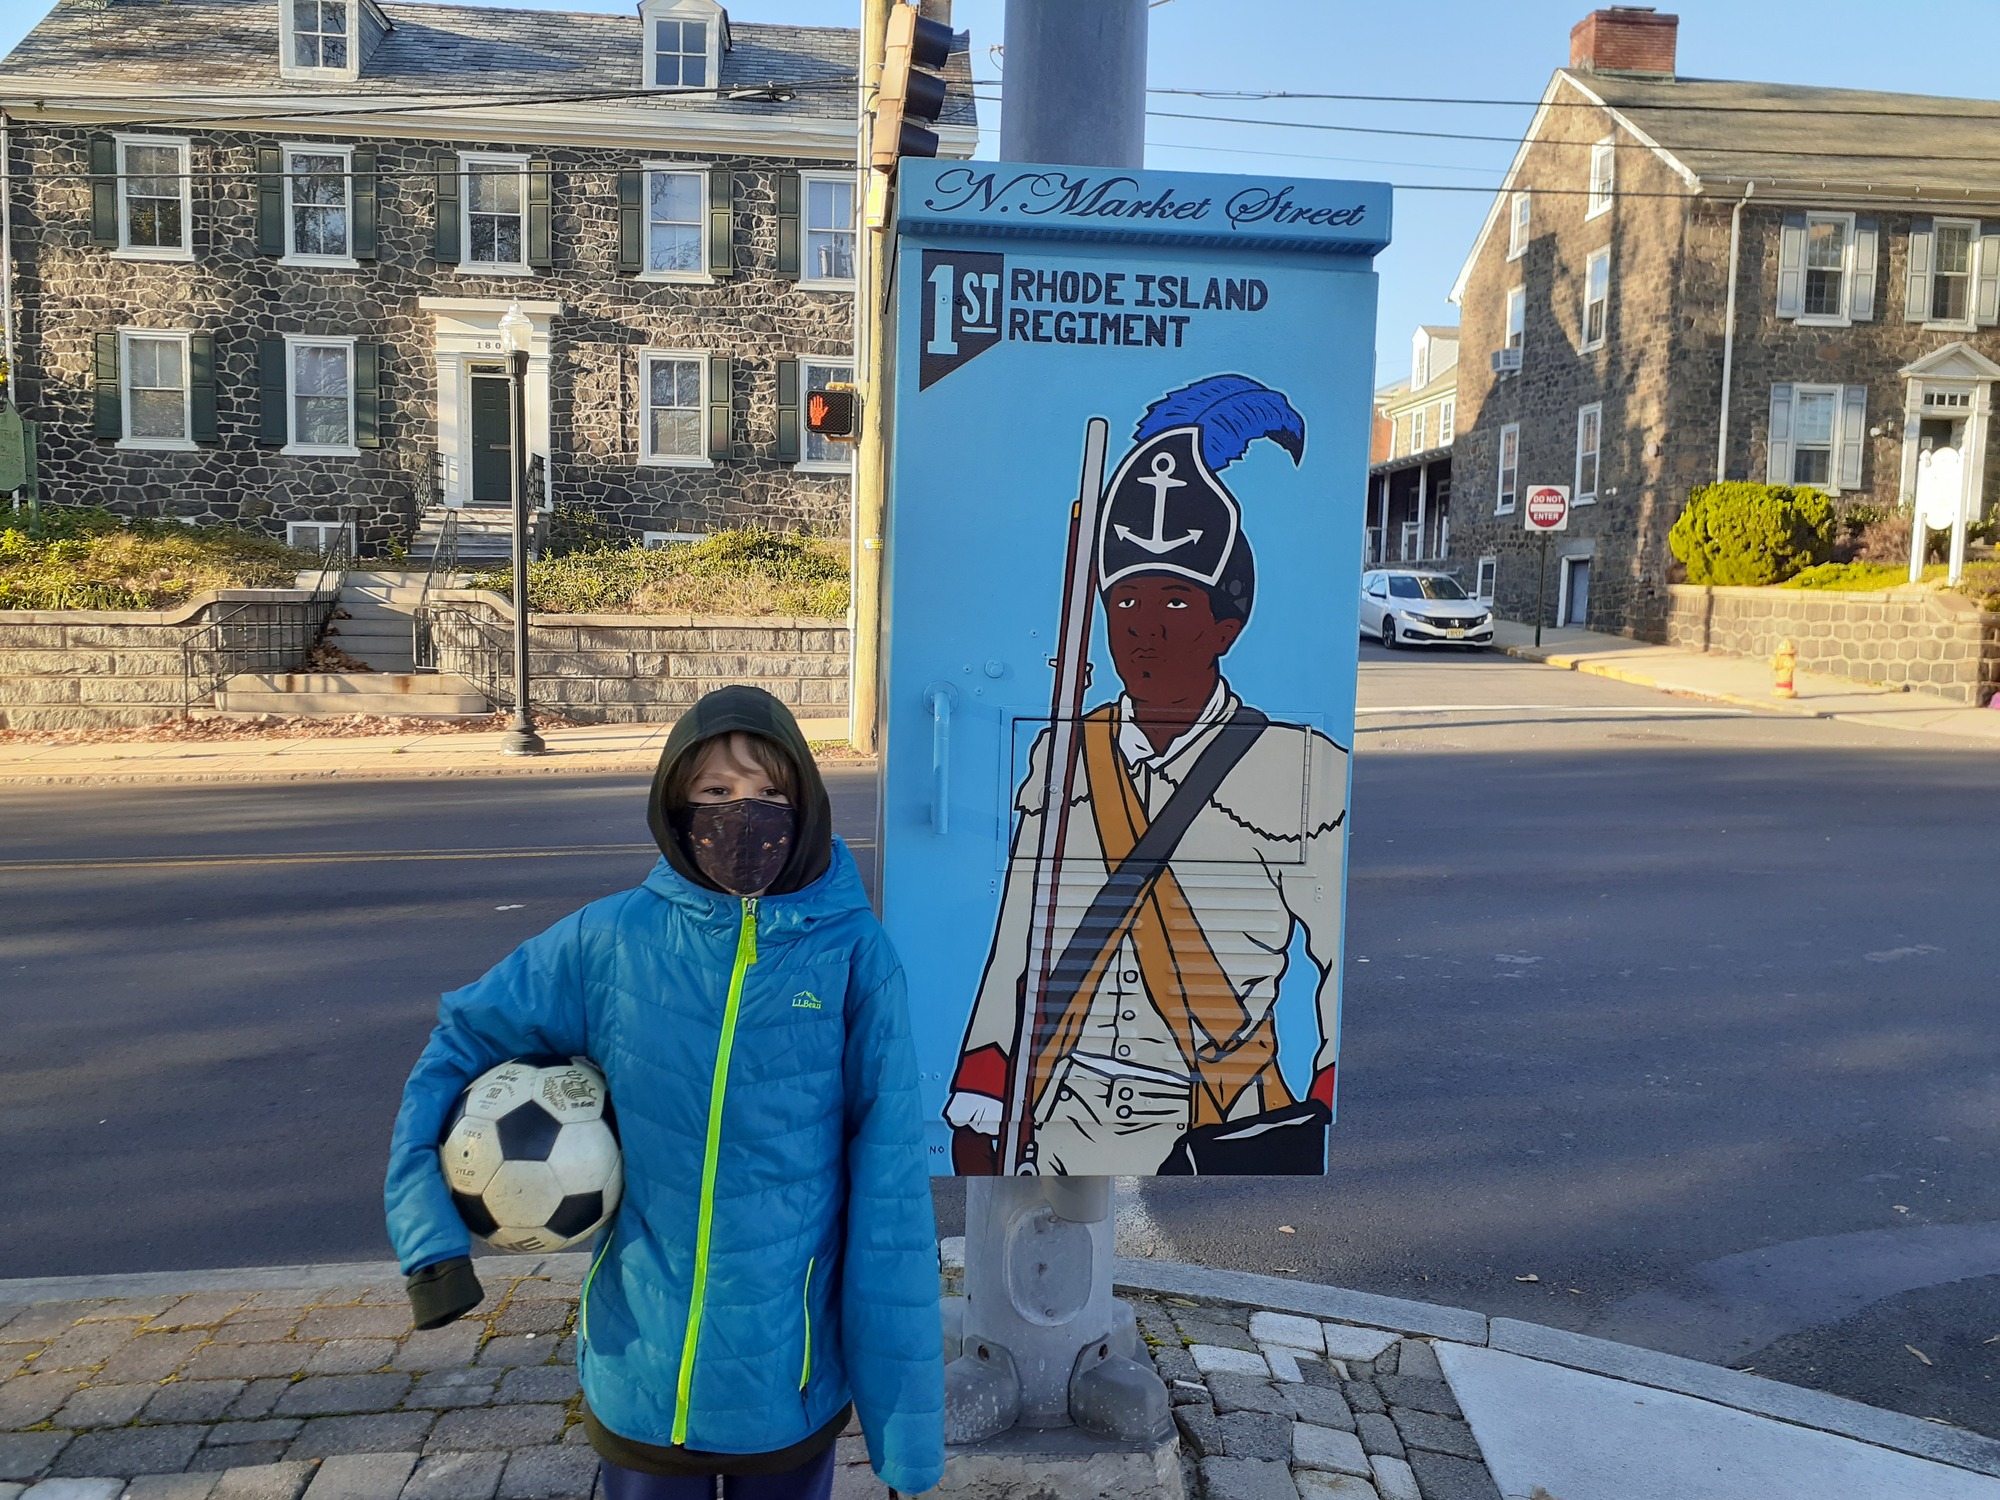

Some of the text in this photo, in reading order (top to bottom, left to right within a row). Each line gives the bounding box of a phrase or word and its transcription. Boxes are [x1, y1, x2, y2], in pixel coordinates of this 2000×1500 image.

[925, 168, 1367, 230] N. Market Street
[1010, 267, 1269, 311] RHODE ISLAND
[1008, 307, 1191, 347] REGIMENT
[1533, 495, 1562, 503] DO NOT
[1533, 512, 1559, 520] ENTER
